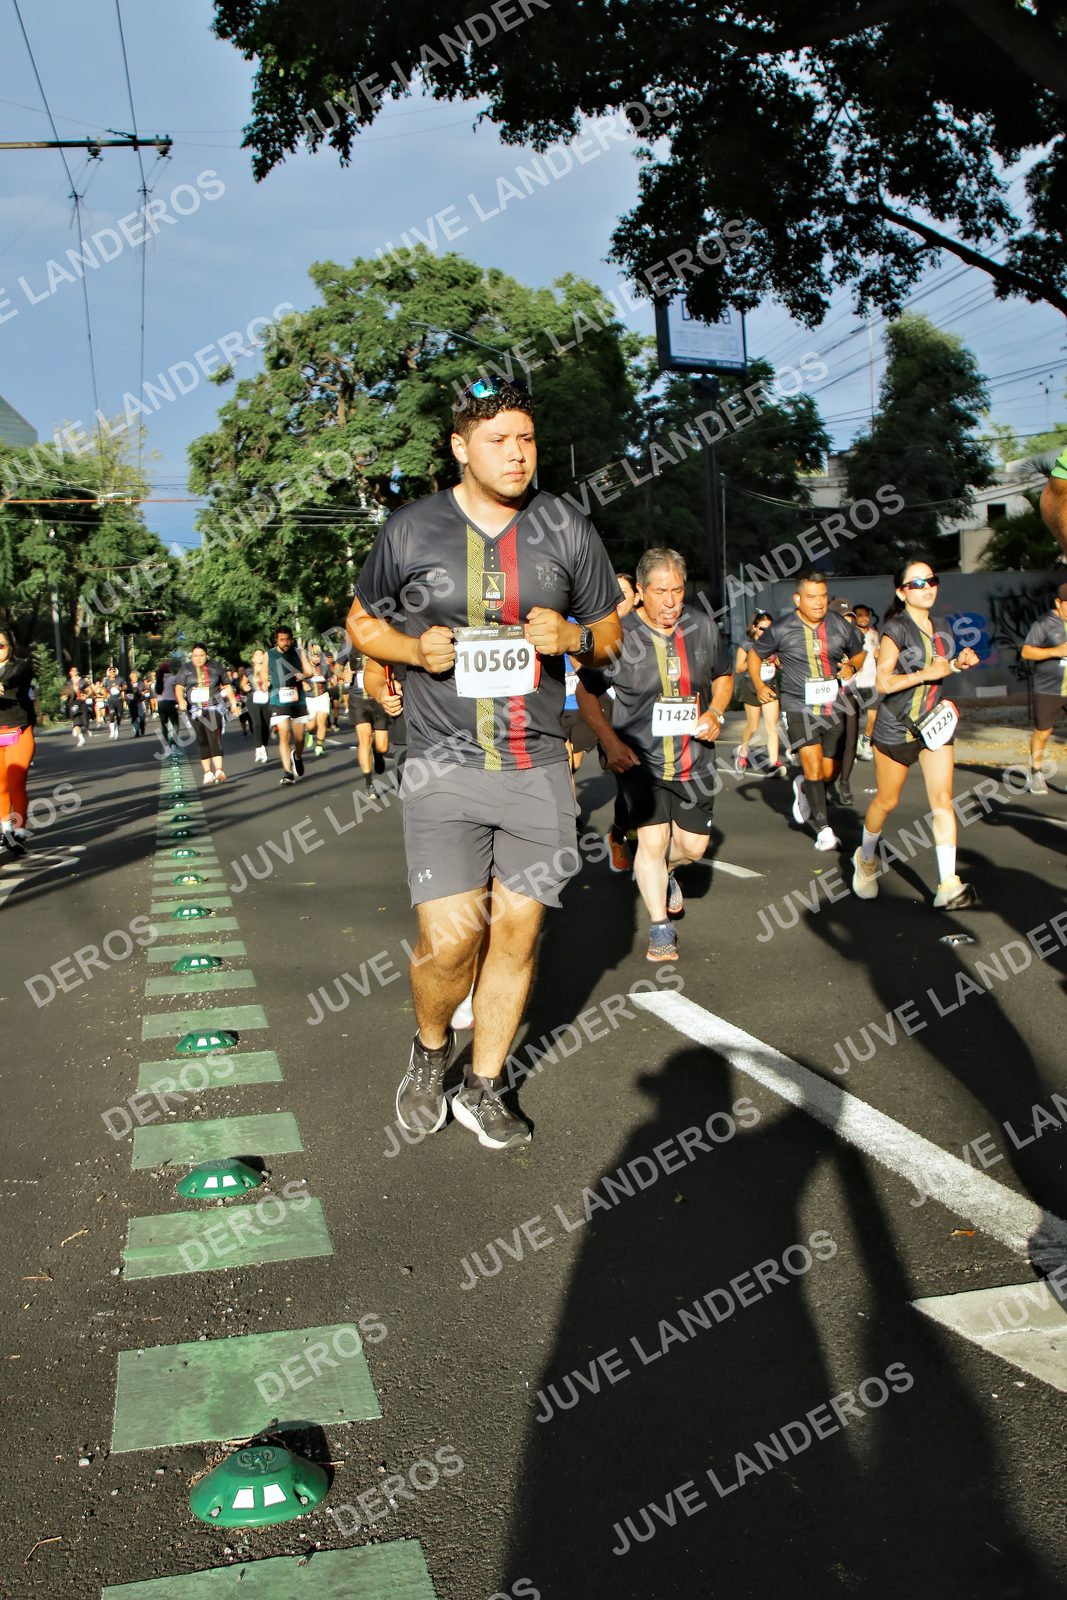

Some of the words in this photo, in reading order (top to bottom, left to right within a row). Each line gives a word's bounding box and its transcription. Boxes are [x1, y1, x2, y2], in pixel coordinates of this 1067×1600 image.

[458, 648, 530, 672] 10569
[658, 708, 696, 721] 11428
[926, 711, 953, 740] 11229
